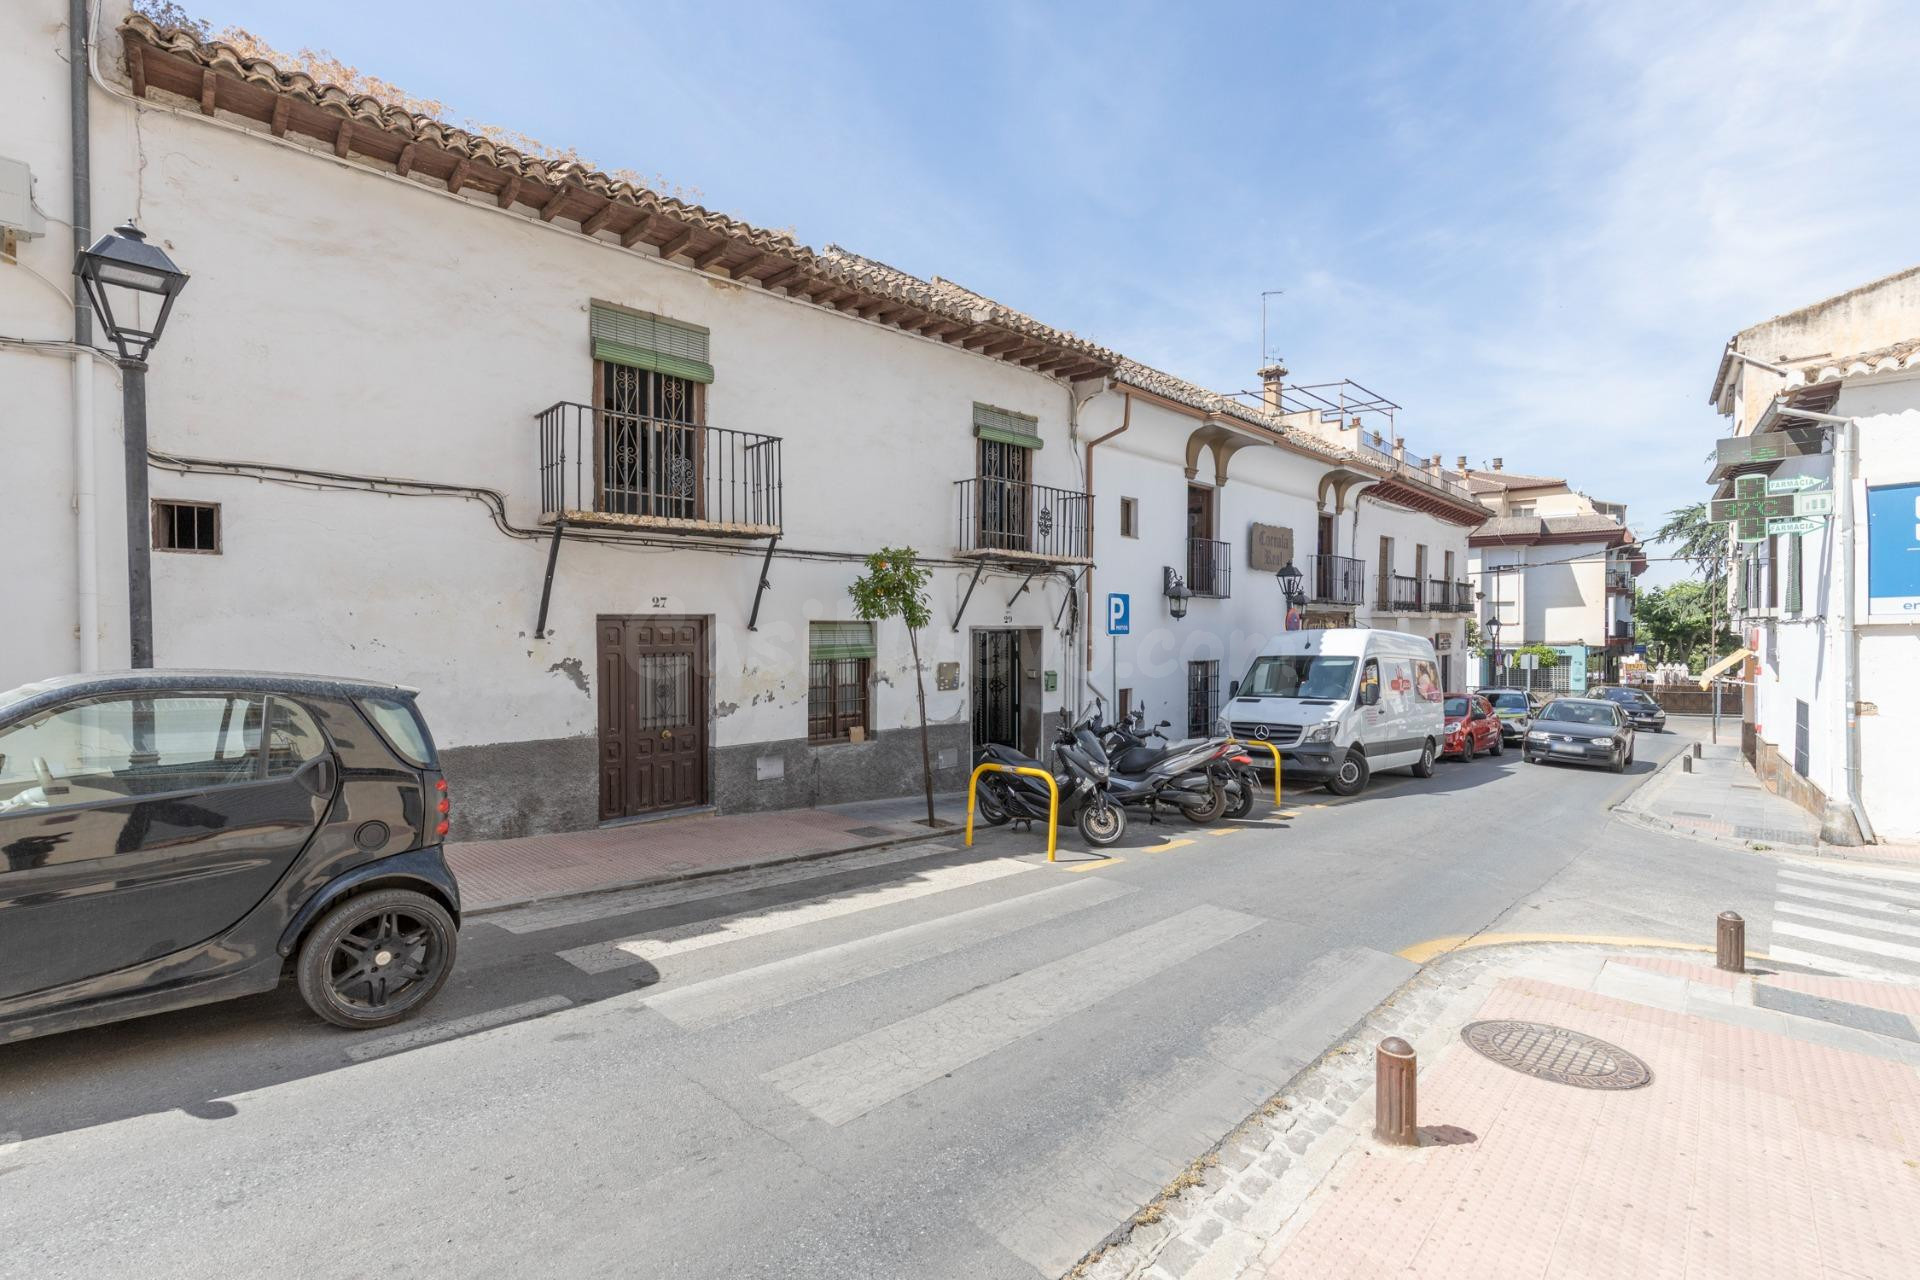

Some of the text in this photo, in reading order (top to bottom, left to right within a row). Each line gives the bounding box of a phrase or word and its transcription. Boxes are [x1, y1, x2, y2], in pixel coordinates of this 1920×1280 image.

[1770, 479, 1814, 488] FARMACIA
[1770, 523, 1814, 531] FARMACIA
[651, 596, 667, 608] 27
[1110, 597, 1125, 631] P
